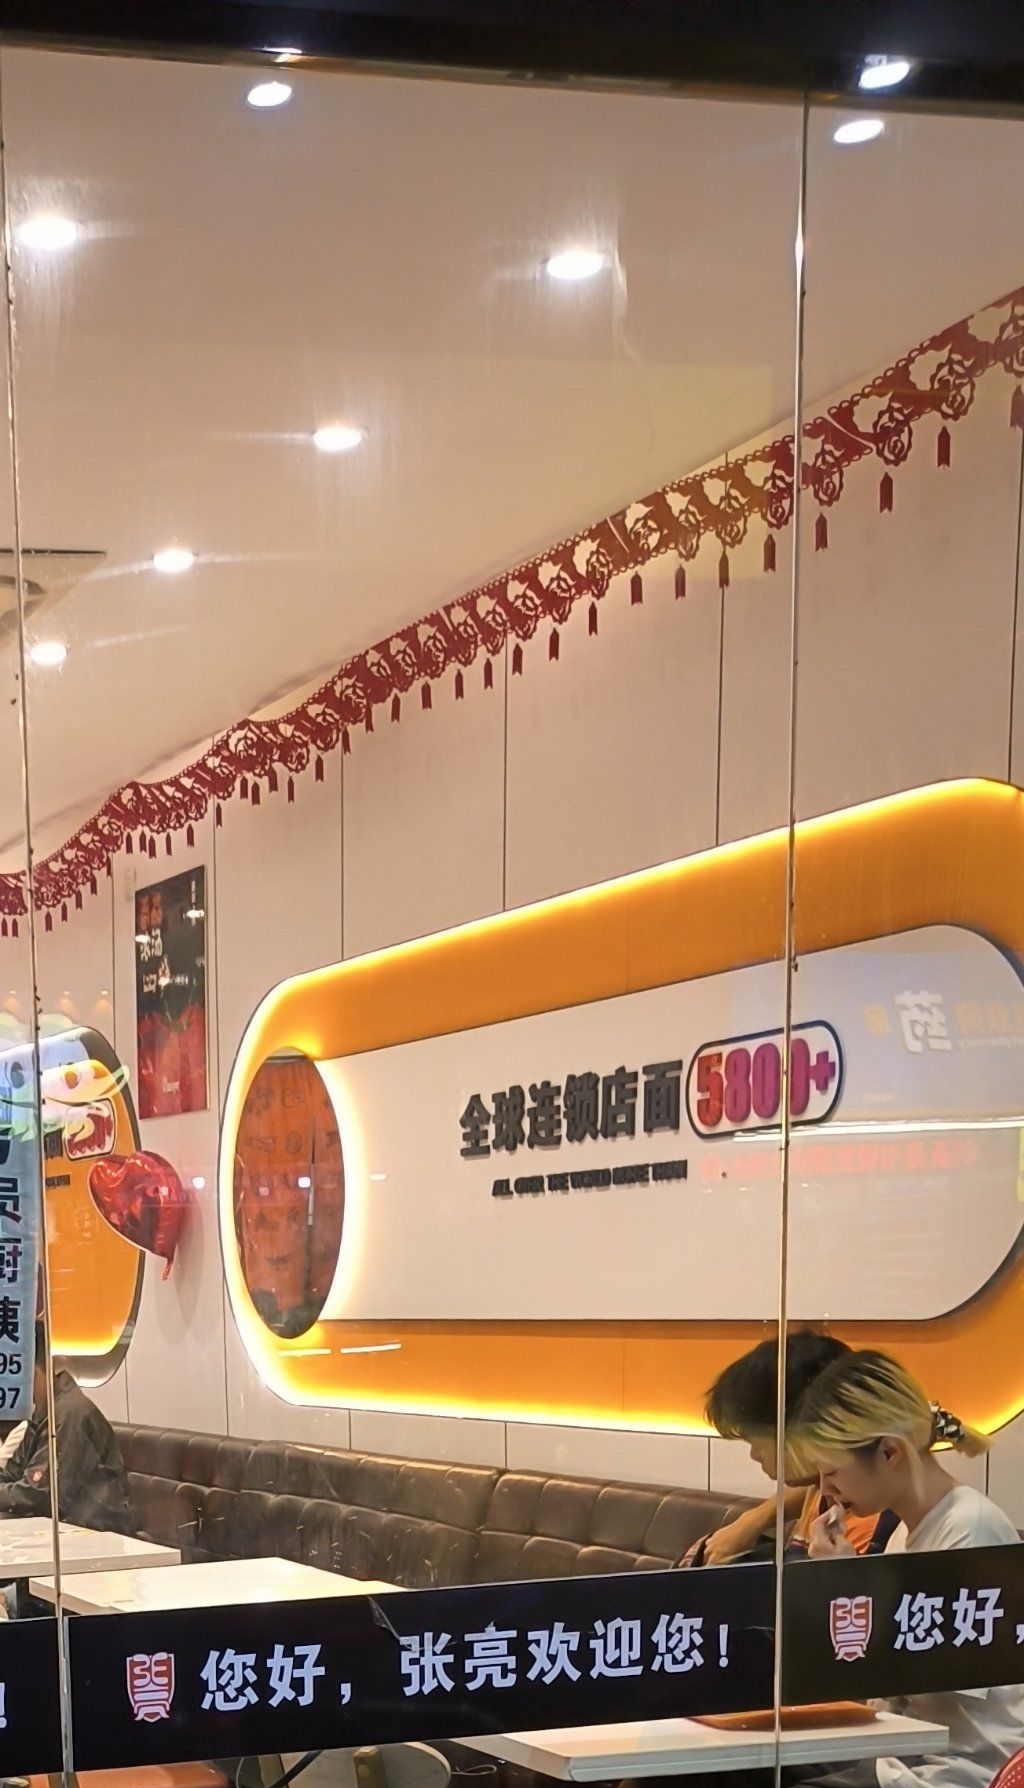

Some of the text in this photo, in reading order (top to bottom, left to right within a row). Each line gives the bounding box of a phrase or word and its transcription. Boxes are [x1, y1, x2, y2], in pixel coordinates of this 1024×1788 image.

[460, 1060, 684, 1157] 全球连锁店面
[697, 1038, 836, 1128] 5800+
